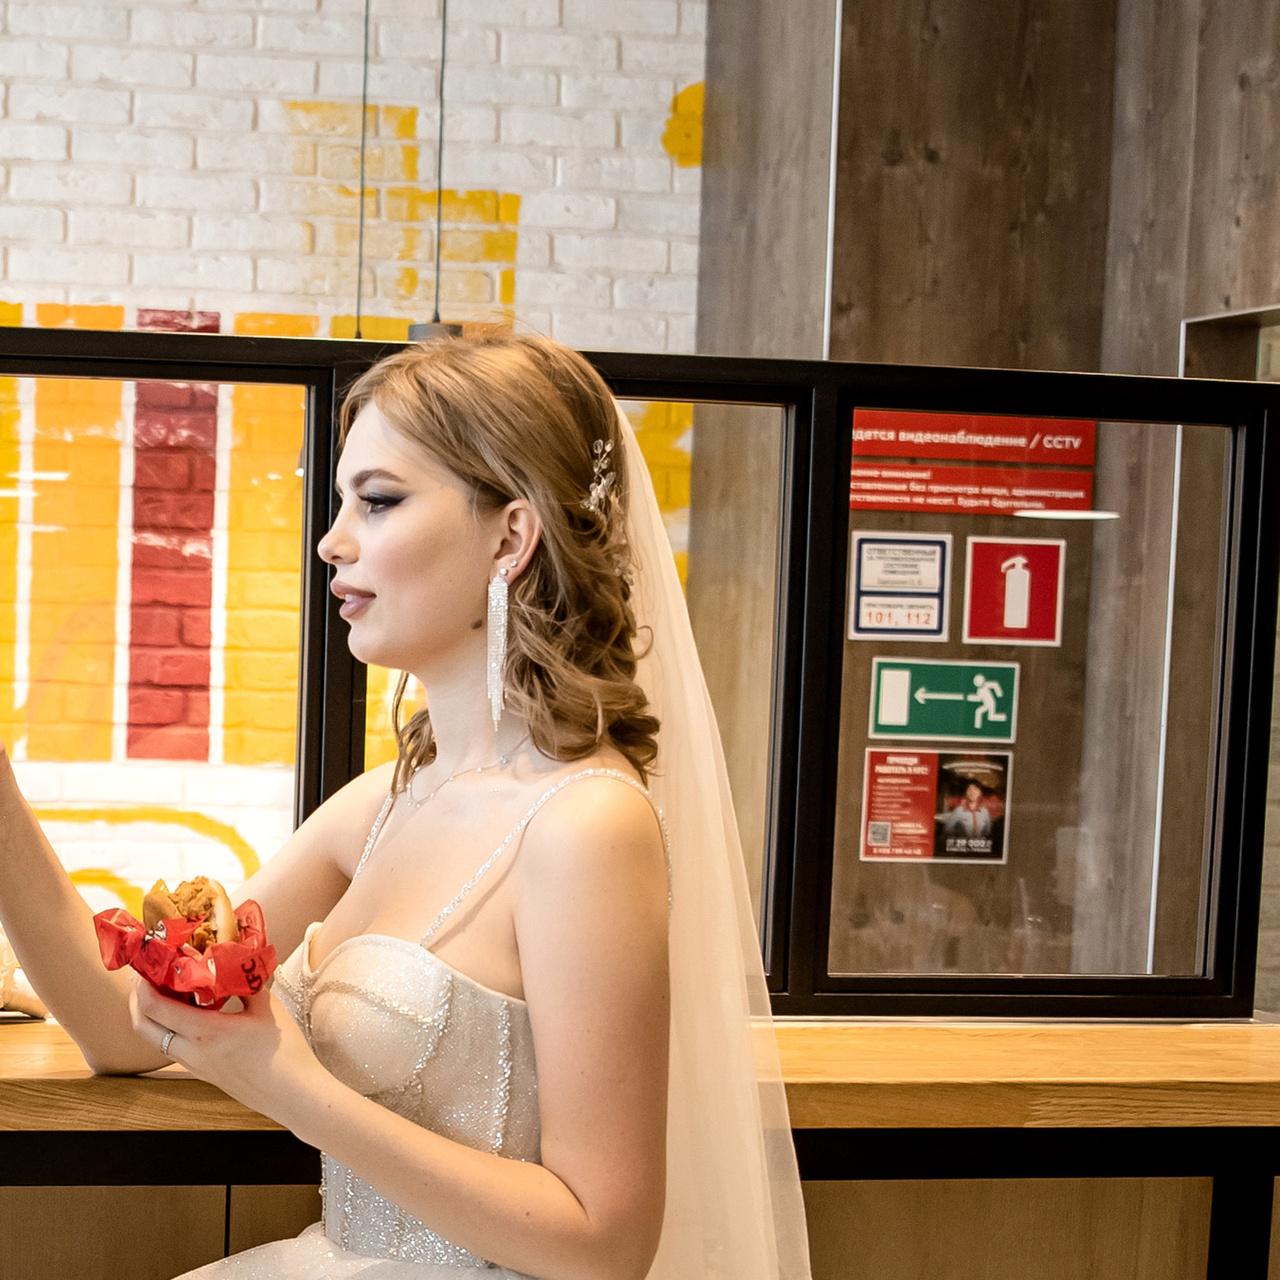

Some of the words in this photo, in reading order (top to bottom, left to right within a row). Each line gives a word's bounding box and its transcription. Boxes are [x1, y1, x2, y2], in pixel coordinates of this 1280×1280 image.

[852, 429, 895, 442] дется
[898, 429, 1028, 447] видеонаблюдение
[1029, 432, 1042, 449] /
[1042, 435, 1082, 449] CCTV
[867, 611, 898, 626] 101,
[906, 612, 931, 625] 112
